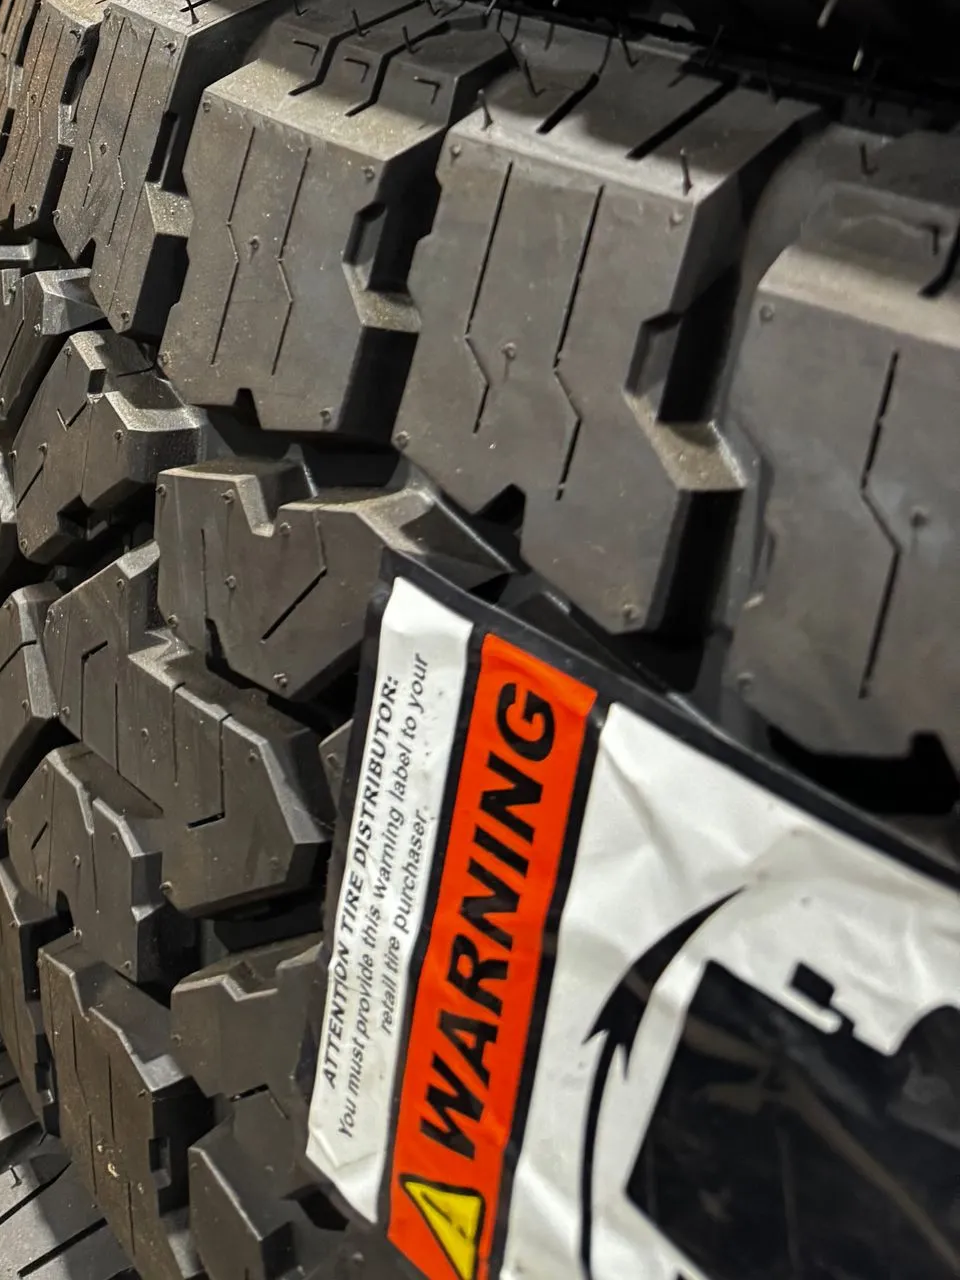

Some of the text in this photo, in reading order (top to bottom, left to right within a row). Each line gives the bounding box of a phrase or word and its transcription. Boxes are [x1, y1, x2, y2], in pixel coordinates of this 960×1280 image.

[323, 675, 399, 1090] ATTENTION TIRE DISTRIBUTOR:
[338, 652, 429, 1139] You must provide this warning label to your
[381, 975, 398, 1036] retail
[384, 934, 401, 971] tire
[420, 681, 557, 1160] WARNING
